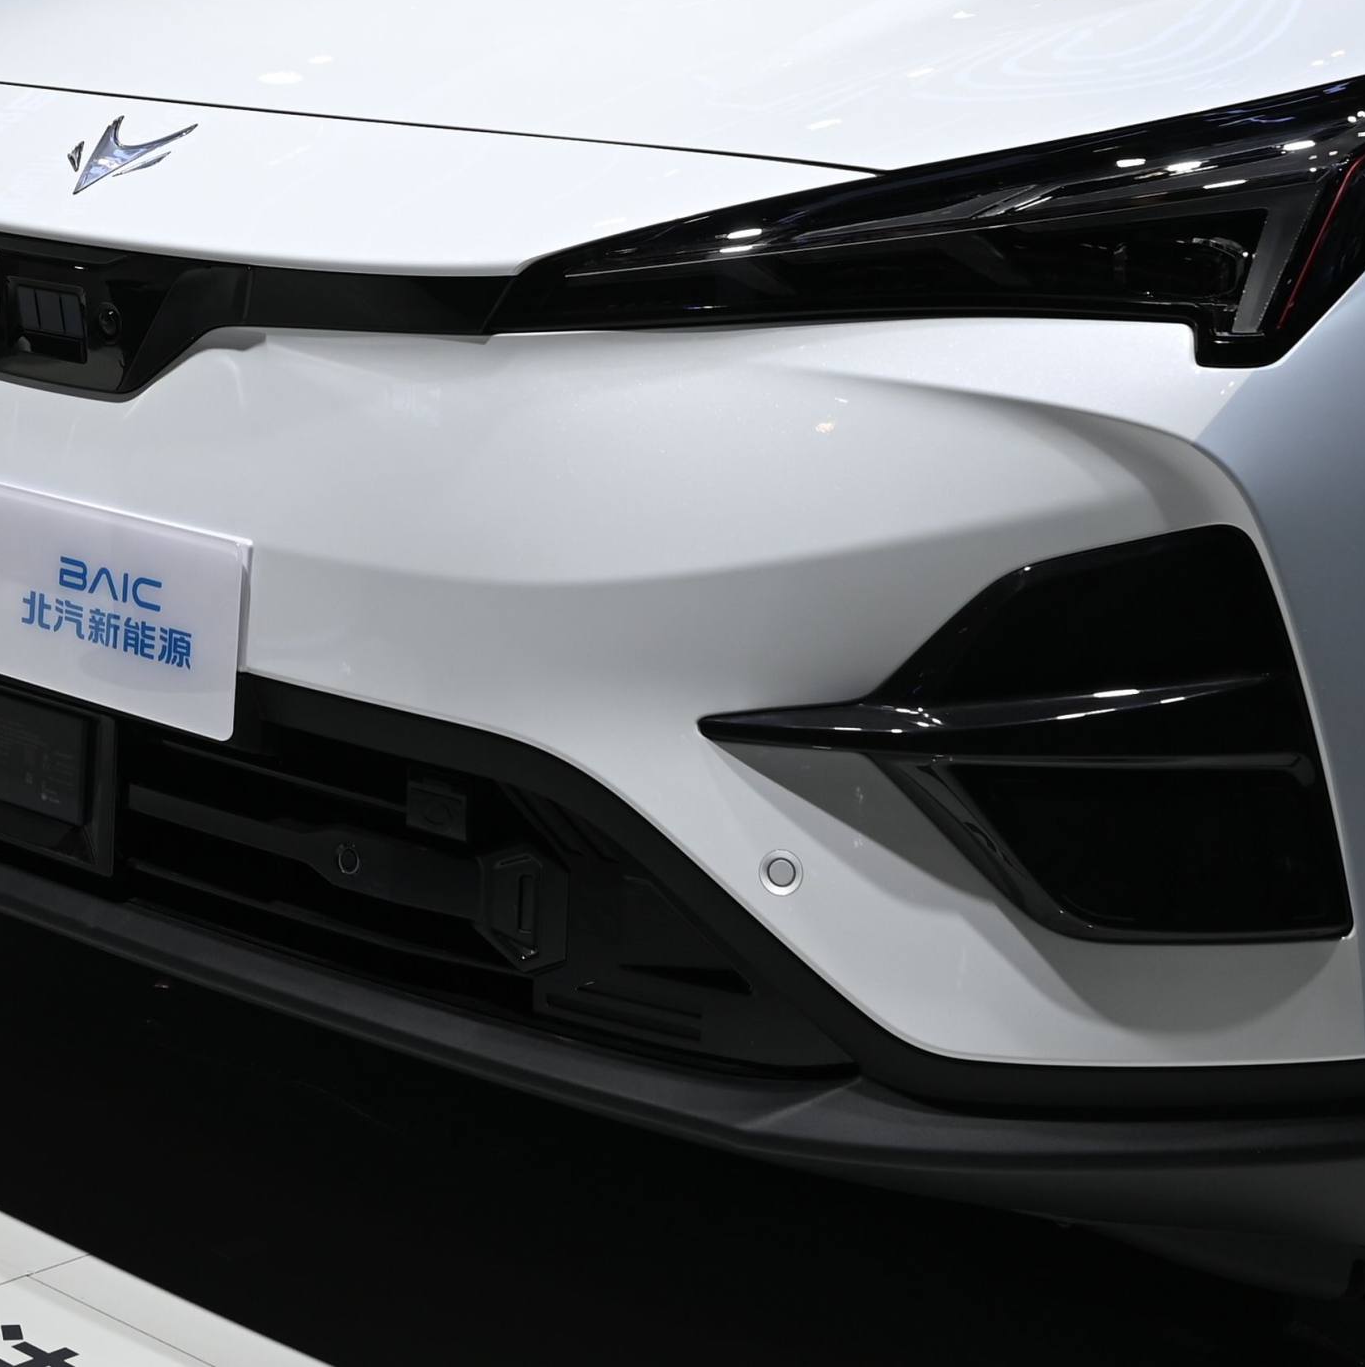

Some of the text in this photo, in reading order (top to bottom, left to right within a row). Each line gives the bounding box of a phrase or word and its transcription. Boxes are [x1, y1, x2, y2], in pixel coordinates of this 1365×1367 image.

[59, 555, 163, 612] BAIC
[21, 590, 193, 670] 北汽新能源
